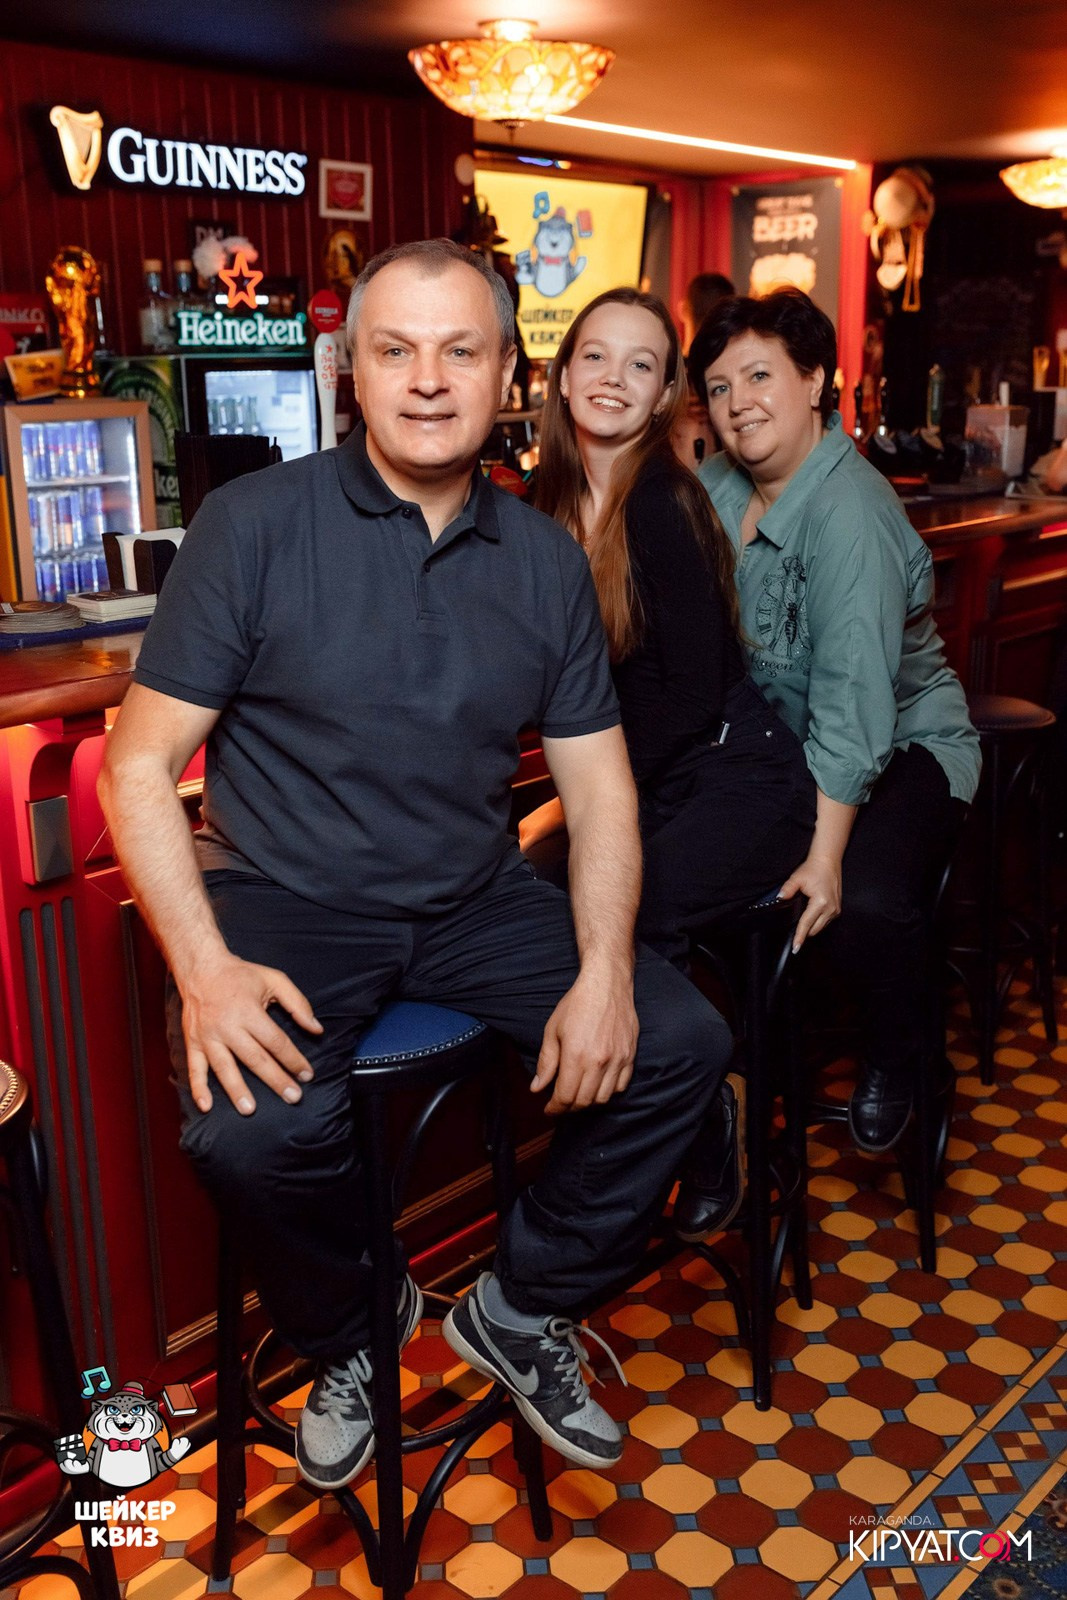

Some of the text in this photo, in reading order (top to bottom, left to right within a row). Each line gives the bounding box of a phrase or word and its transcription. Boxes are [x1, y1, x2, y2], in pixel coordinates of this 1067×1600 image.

[107, 127, 307, 196] GUINNESS
[753, 213, 818, 243] BEER
[176, 310, 307, 346] Heineken
